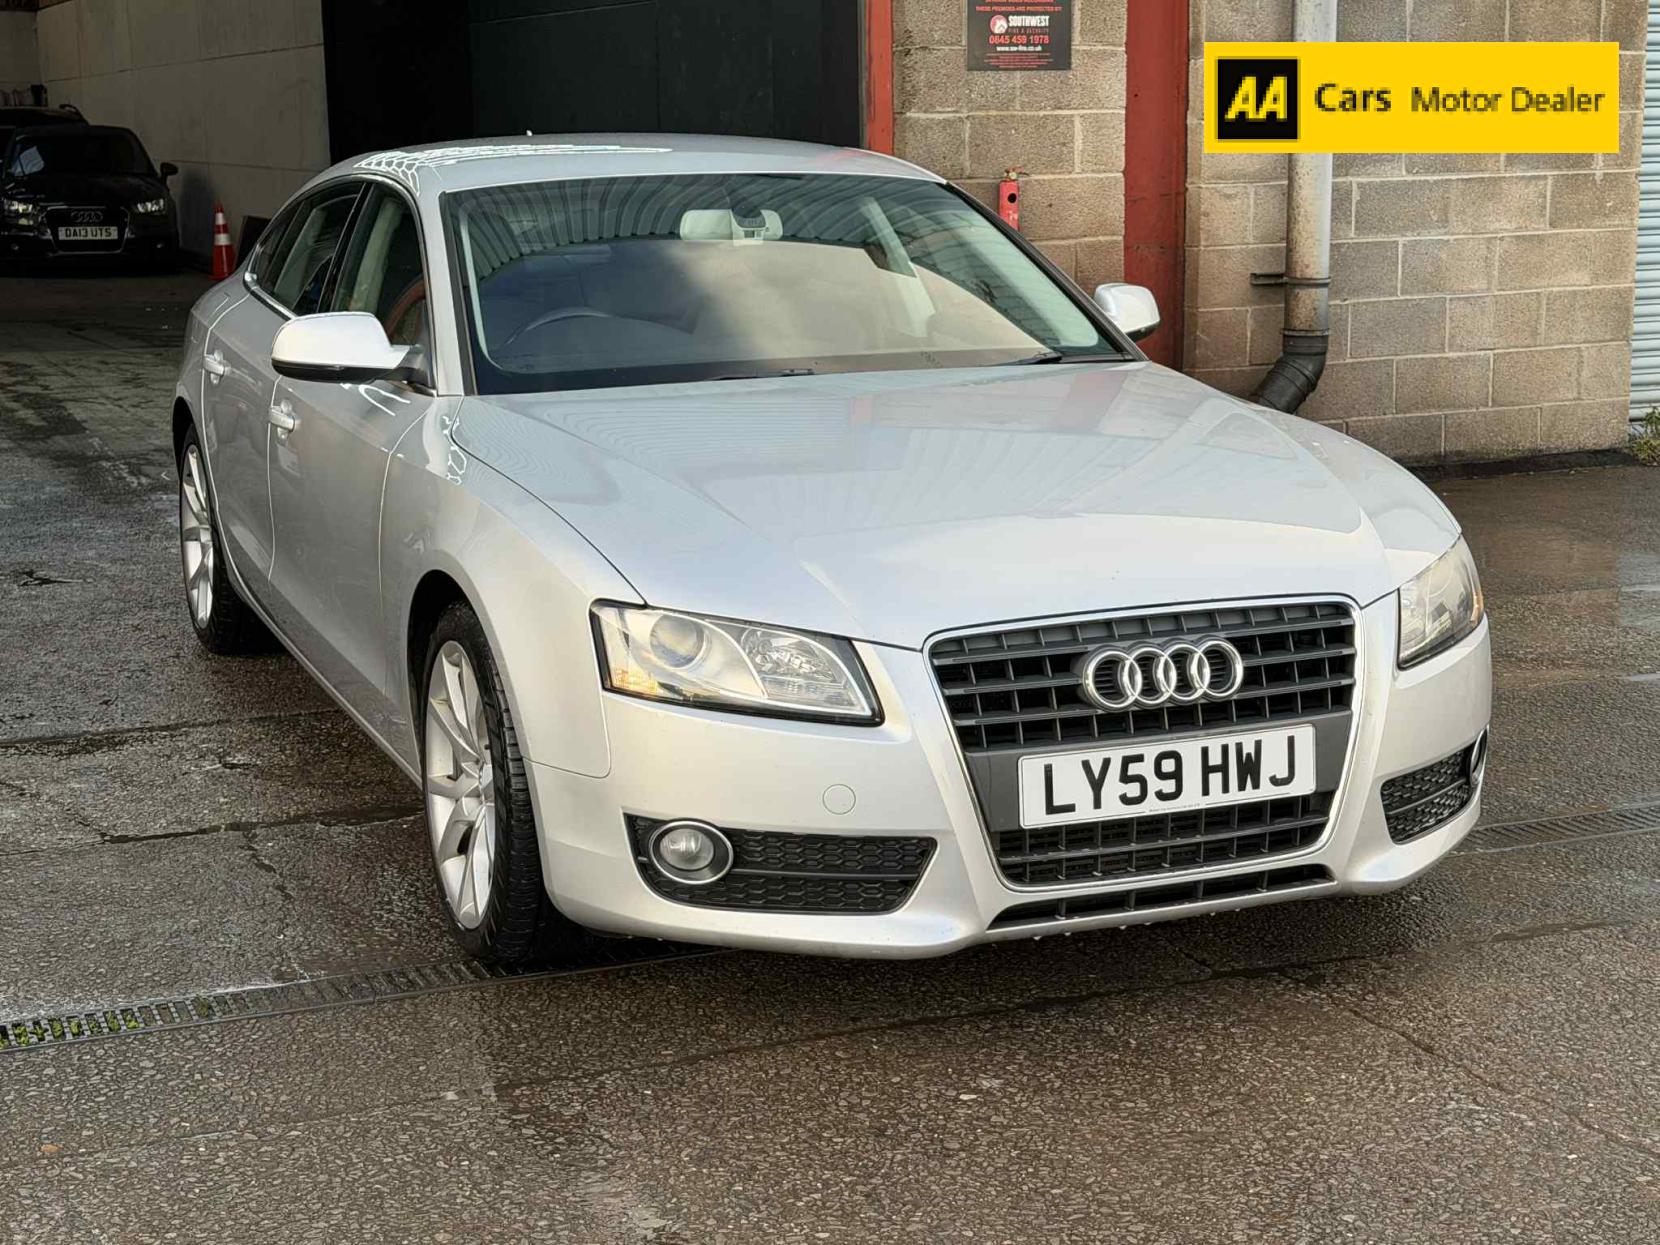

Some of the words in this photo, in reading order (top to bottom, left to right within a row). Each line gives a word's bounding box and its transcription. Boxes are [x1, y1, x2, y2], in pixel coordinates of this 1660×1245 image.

[1008, 16, 1049, 26] SOUTHWEST
[1011, 35, 1027, 45] 459
[1030, 35, 1050, 45] 1978
[65, 227, 89, 238] DA13
[90, 227, 113, 238] UTS
[1043, 749, 1184, 816] LY59
[1200, 734, 1296, 797] HWJ
